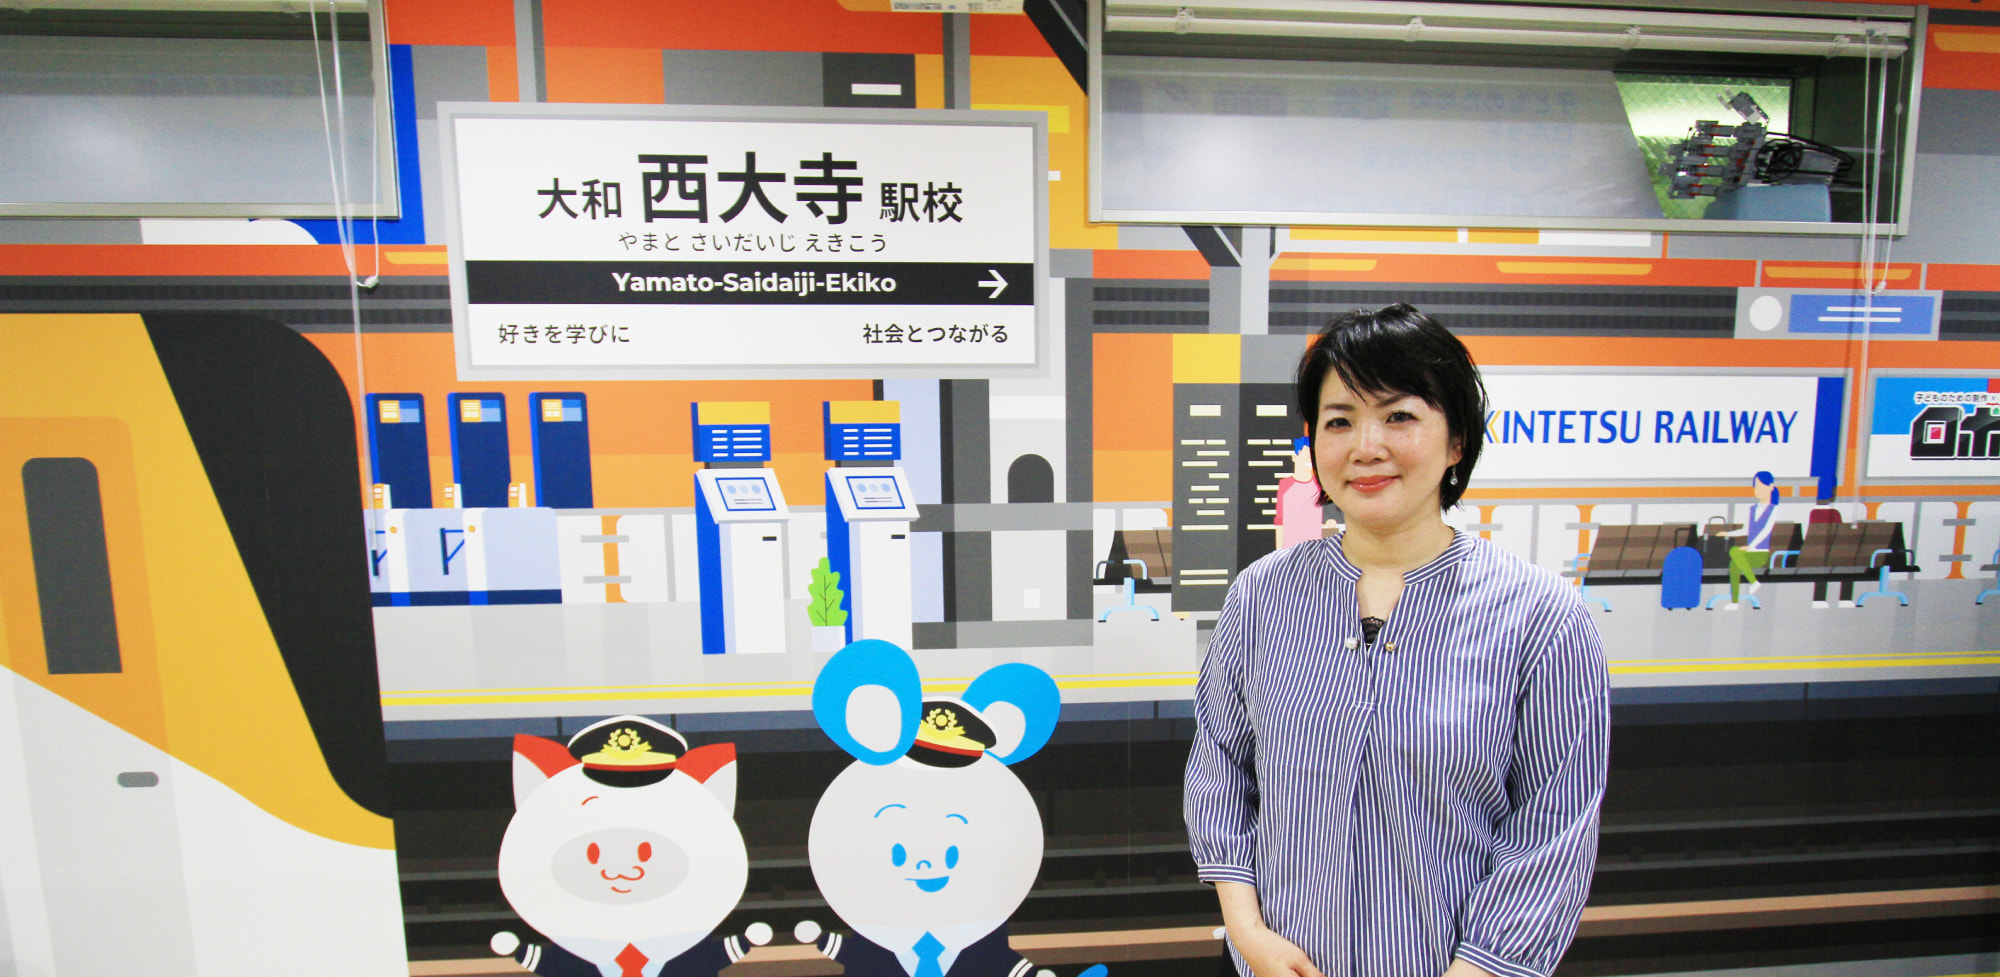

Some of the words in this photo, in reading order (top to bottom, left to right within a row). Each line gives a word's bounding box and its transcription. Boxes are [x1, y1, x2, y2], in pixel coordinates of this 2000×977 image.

[537, 177, 622, 220] 大和
[638, 151, 864, 225] 西大寺
[879, 181, 963, 223] 駅校
[618, 233, 681, 252] やまと
[691, 233, 796, 253] さいだいじ
[806, 233, 887, 253] えきこう
[612, 271, 897, 297] Yamato-Saidaiji-Ekiko
[498, 323, 631, 345] 好きを学びに
[862, 323, 1008, 344] 社会とつながる
[1654, 410, 1798, 444] RAILWAY
